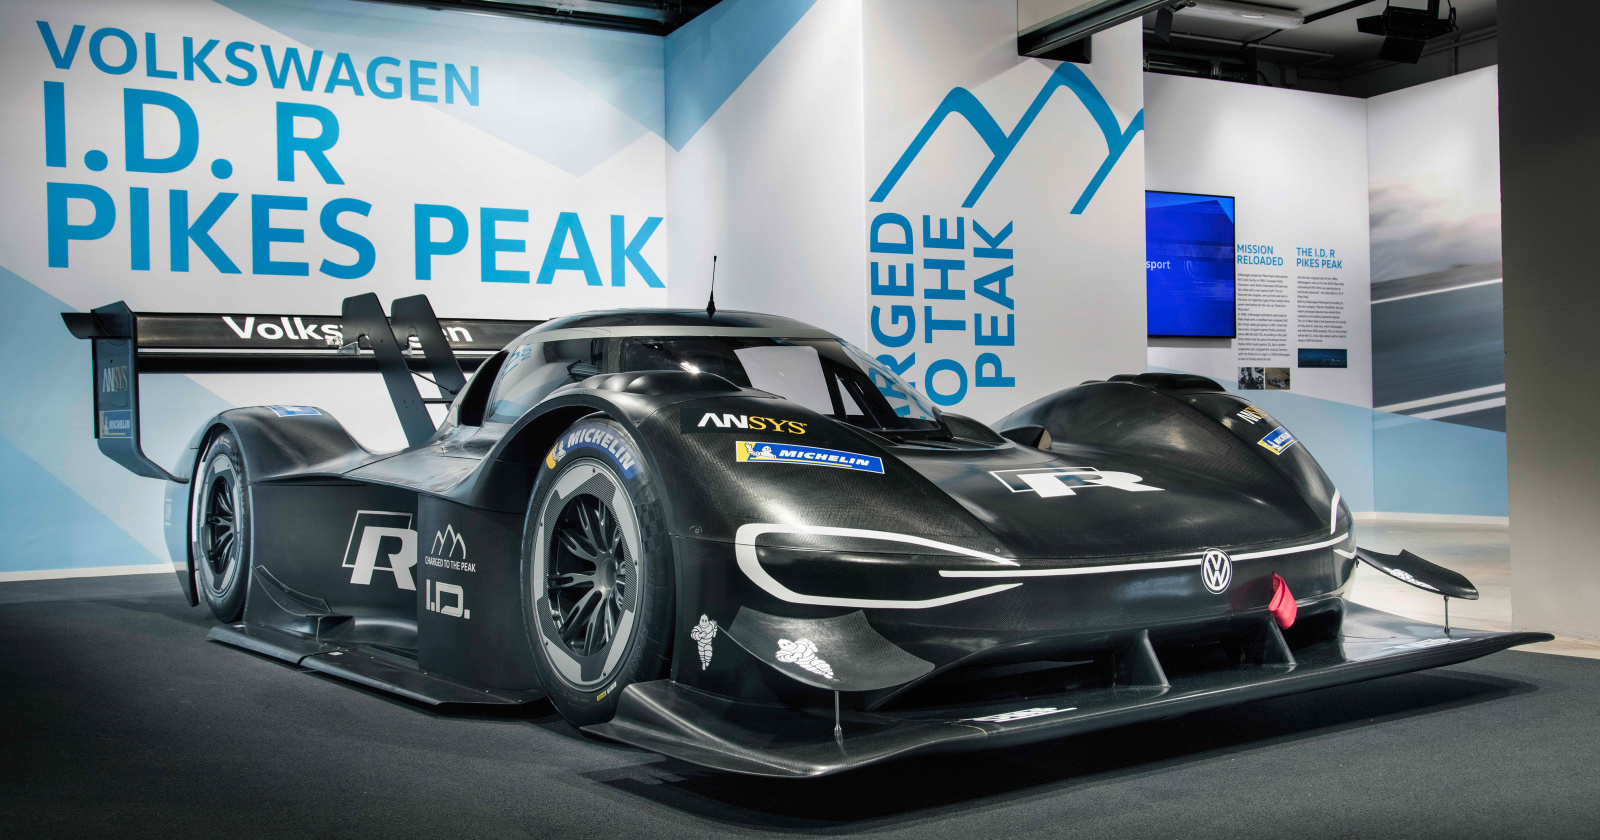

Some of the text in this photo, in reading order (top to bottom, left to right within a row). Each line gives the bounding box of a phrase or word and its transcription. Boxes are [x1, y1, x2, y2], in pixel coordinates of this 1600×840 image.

[36, 20, 480, 106] VOLKSWAGEN
[43, 80, 346, 186] I.D. R
[46, 181, 667, 289] PIKES PEAK
[1236, 244, 1274, 255] MISSION
[1237, 255, 1284, 266] RELOADED
[1296, 247, 1335, 258] THE I.D. R
[1296, 258, 1343, 269] PIKES PEAK
[922, 215, 968, 406] O THE
[972, 219, 1016, 387] PEAK
[102, 366, 128, 393] ANSYS
[697, 412, 807, 435] ANSYS
[567, 428, 635, 471] MICHELIN
[778, 449, 870, 467] MICHELIN
[1017, 470, 1166, 498] R
[350, 525, 418, 591] R
[450, 561, 460, 570] THE
[461, 562, 476, 572] PEAK
